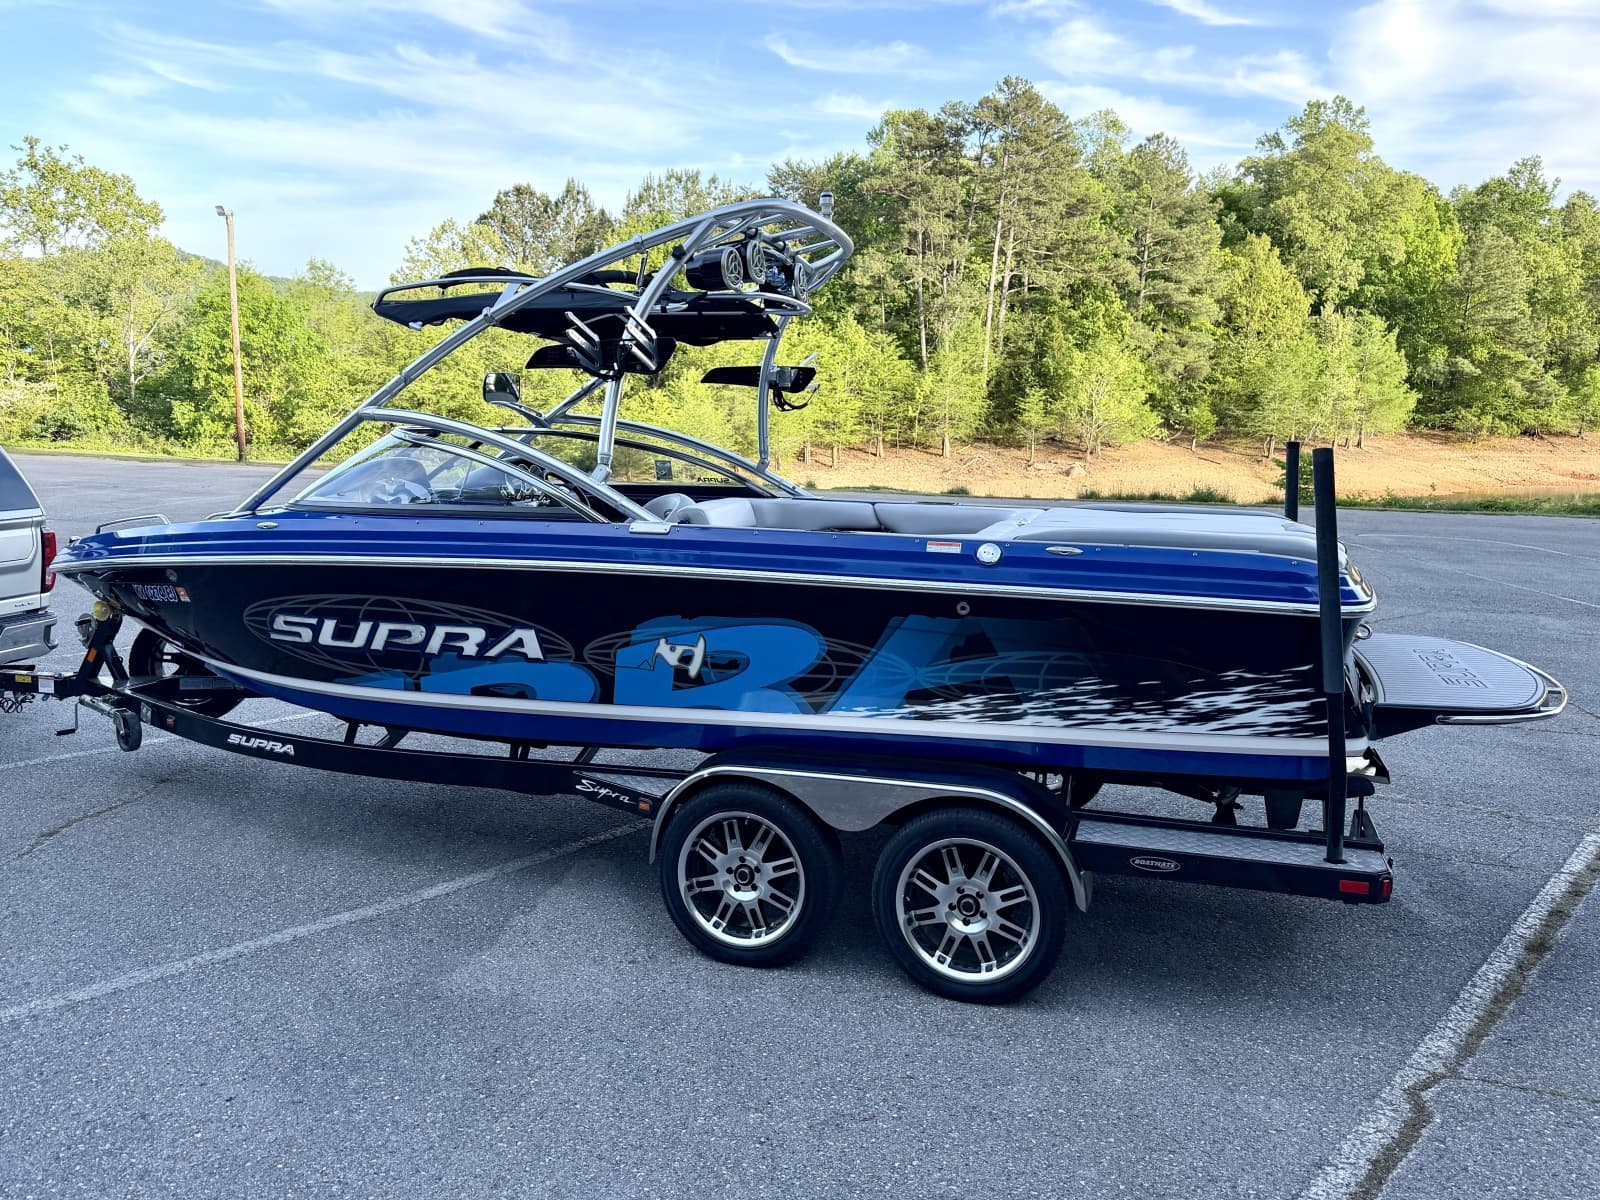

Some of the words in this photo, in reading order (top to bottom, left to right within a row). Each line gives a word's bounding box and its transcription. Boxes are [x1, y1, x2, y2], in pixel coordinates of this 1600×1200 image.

[506, 494, 550, 502] SUPRA
[270, 614, 544, 661] SUPRA
[227, 733, 295, 756] SUPRA
[576, 779, 637, 804] Supra
